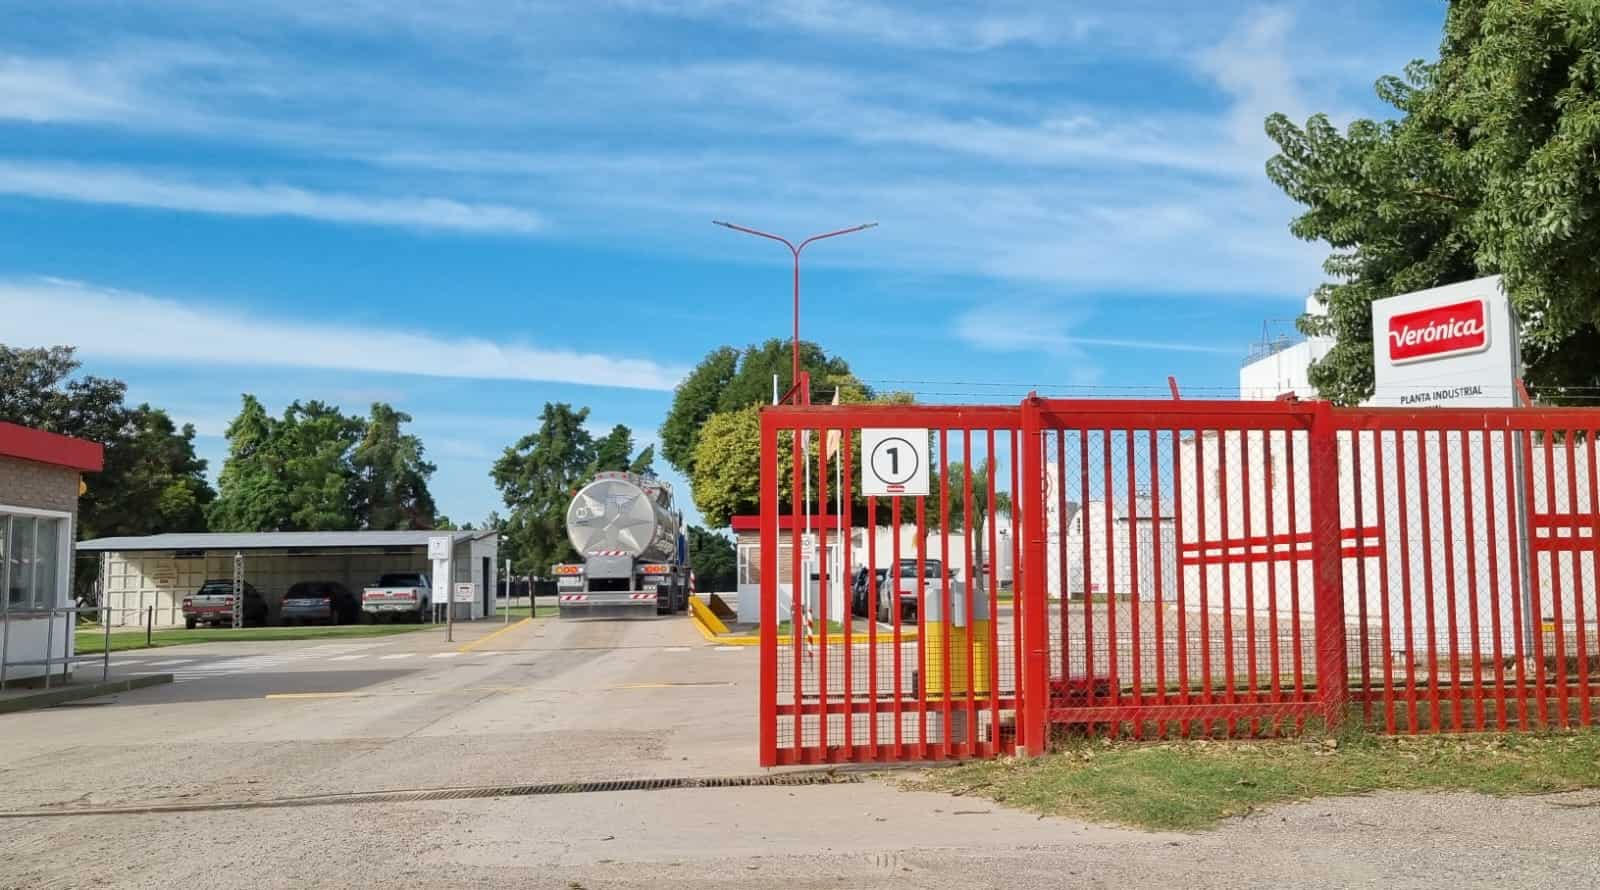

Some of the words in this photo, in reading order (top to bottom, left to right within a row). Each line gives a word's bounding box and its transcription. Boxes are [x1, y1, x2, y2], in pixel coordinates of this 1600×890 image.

[1390, 318, 1484, 348] Verónica
[1400, 392, 1431, 405] PLANTA
[1433, 385, 1483, 400] INDUSTRIAL
[886, 447, 899, 475] 1
